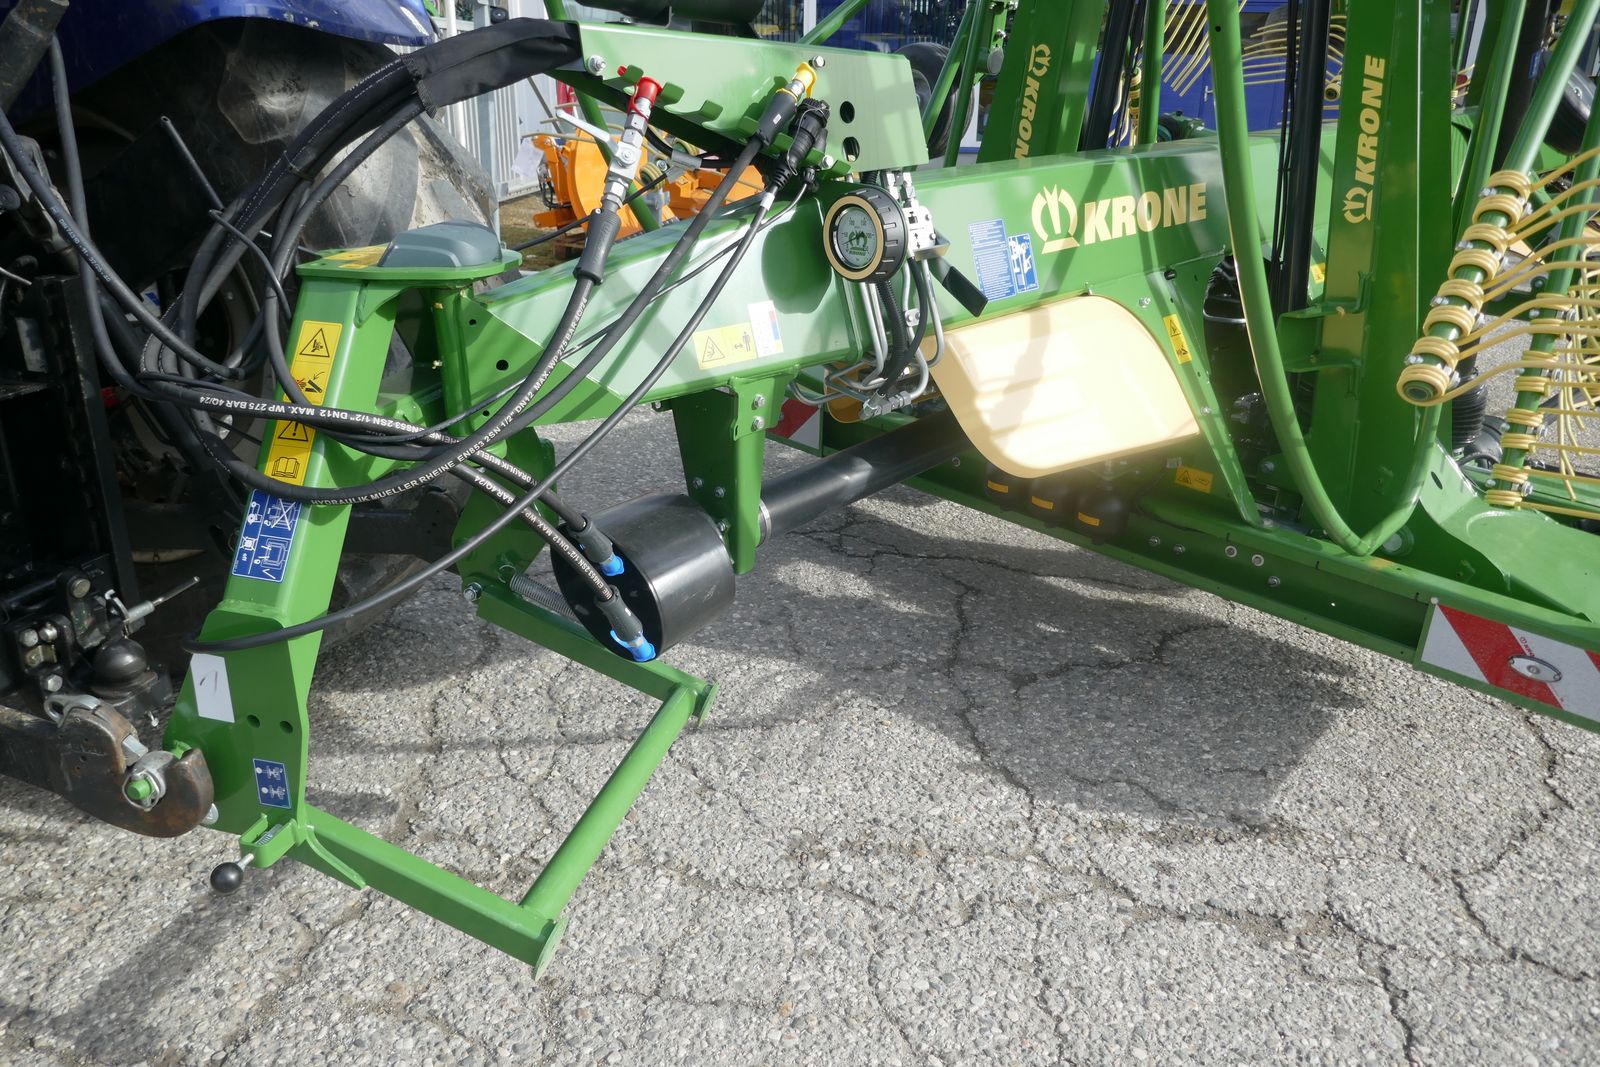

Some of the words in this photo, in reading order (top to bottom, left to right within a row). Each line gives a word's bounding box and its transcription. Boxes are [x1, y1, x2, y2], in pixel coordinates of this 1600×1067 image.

[1354, 54, 1386, 186] KRONE
[1084, 182, 1207, 245] KRONE
[199, 396, 225, 407] 4Q/24
[225, 399, 248, 410] BAR
[248, 401, 268, 412] 275
[268, 403, 286, 413] WP
[288, 405, 315, 416] MAX.
[311, 494, 369, 506] HYDRAULIK
[370, 479, 420, 501] MUELLER
[418, 460, 456, 484] RHEINE
[456, 439, 485, 462] EN853
[484, 426, 502, 443] 2SN
[515, 391, 535, 414] DN12
[533, 370, 551, 391] MAX.
[547, 354, 560, 370] WP
[557, 340, 568, 357] 275
[564, 320, 578, 341] BAR
[319, 408, 349, 420] DN12
[373, 417, 394, 428] 2SN
[474, 475, 498, 493] 4Q/24
[496, 489, 516, 505] BAR
[552, 534, 570, 552] DN12
